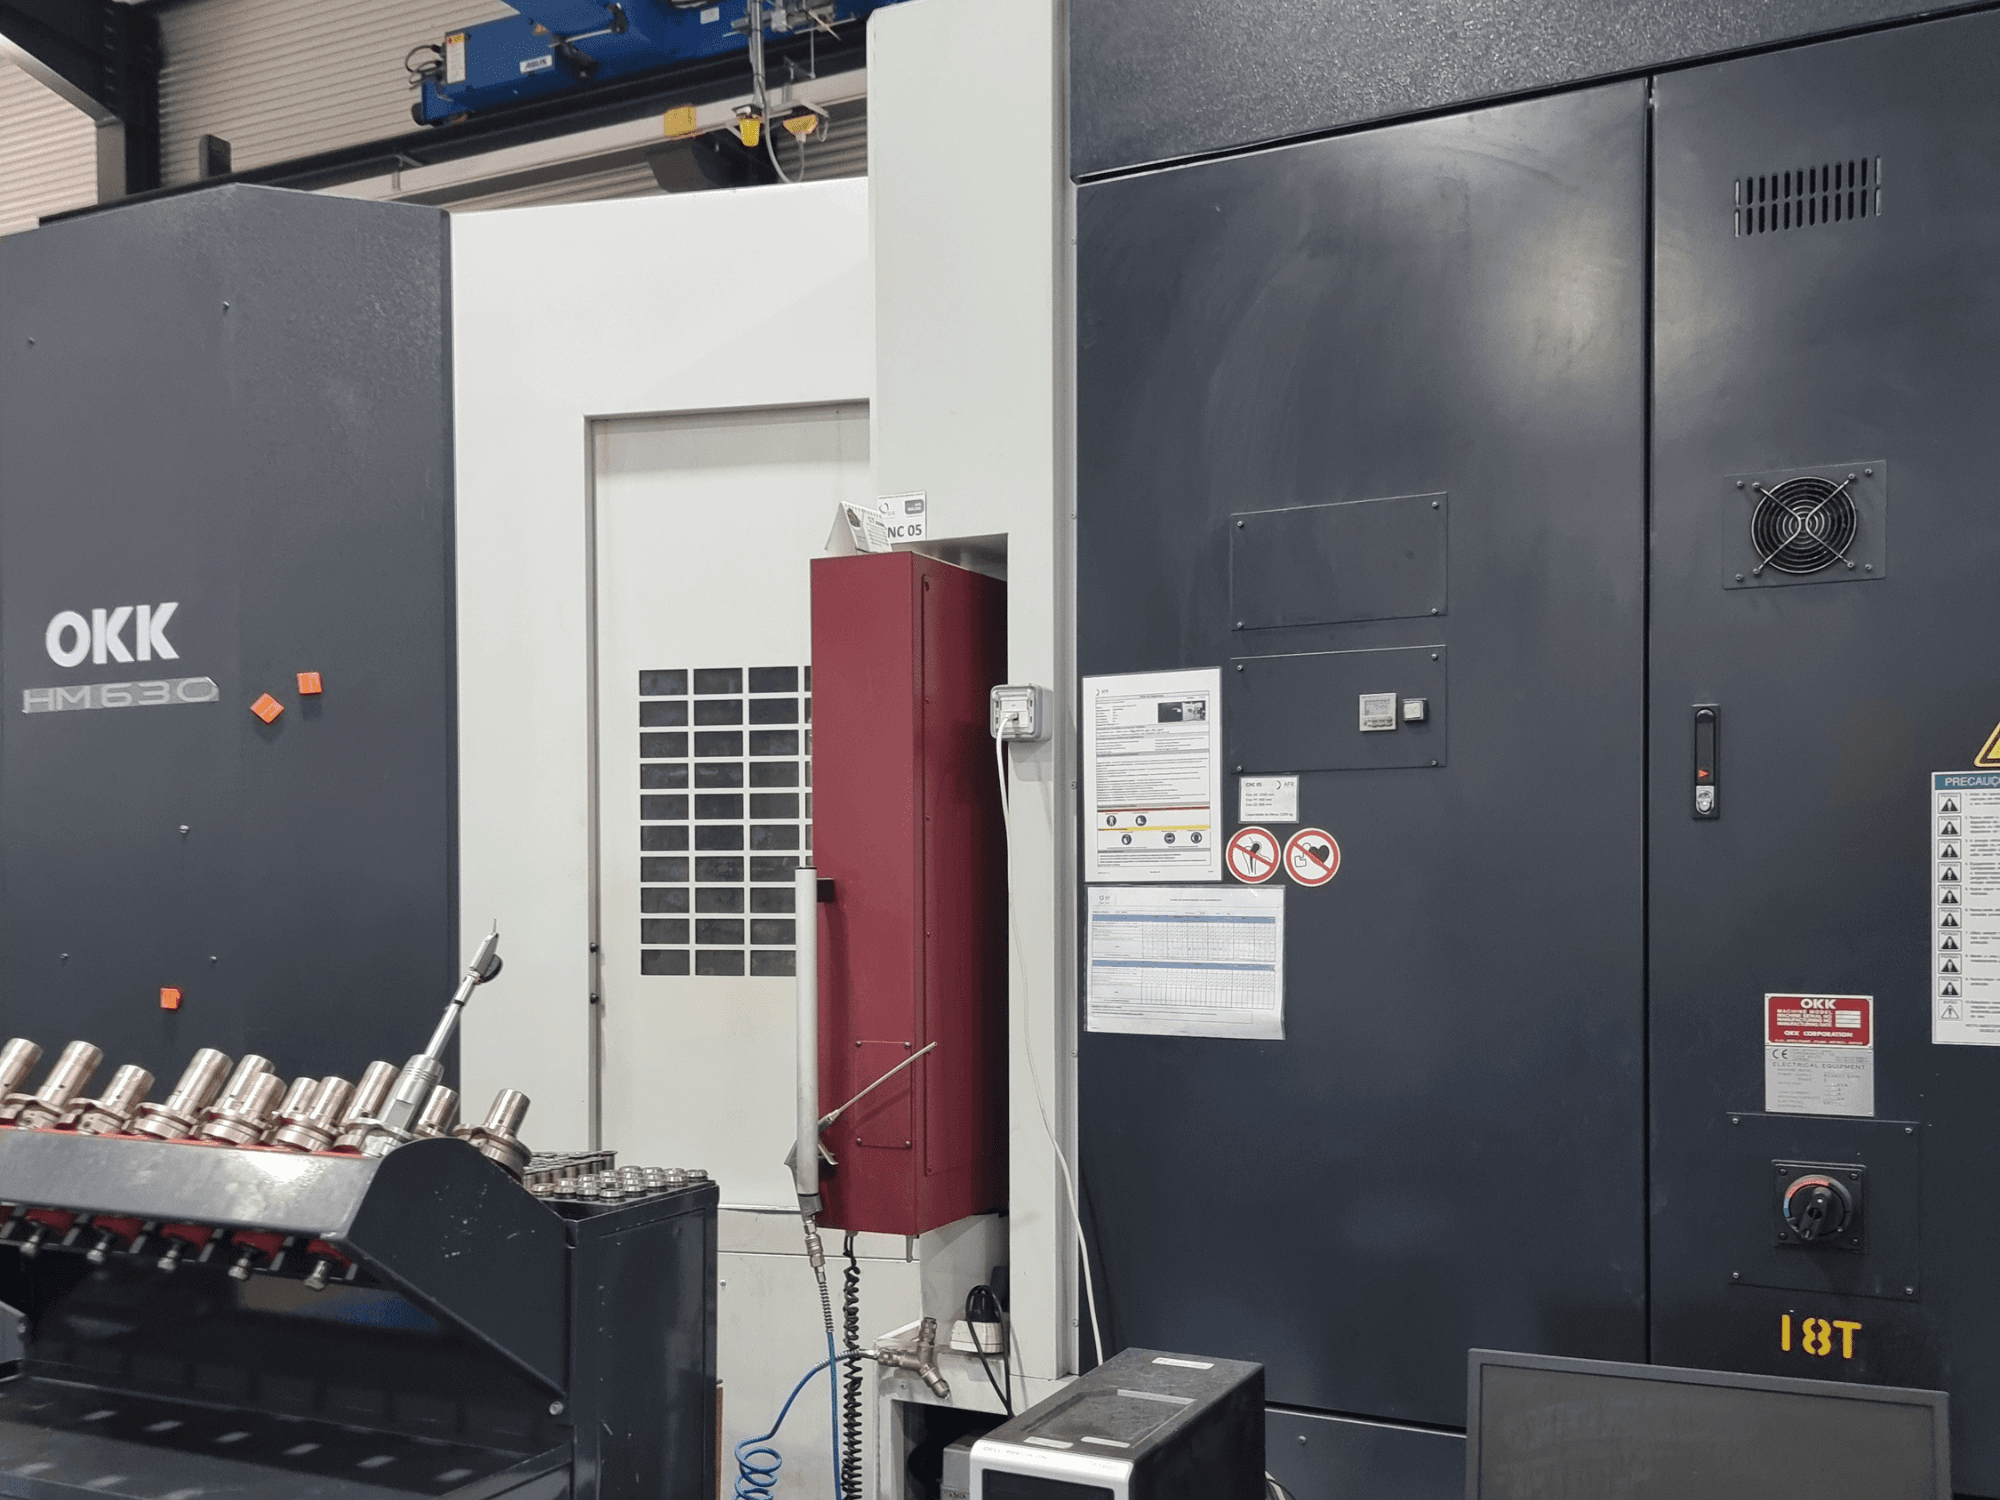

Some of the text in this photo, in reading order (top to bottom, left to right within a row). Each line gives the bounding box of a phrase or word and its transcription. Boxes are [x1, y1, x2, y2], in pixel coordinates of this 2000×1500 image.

[887, 524, 922, 538] NC 05
[46, 602, 179, 667] OKK
[24, 677, 214, 711] HM630
[1945, 776, 2000, 787] PRECAUÇ
[1800, 998, 1836, 1009] OKK
